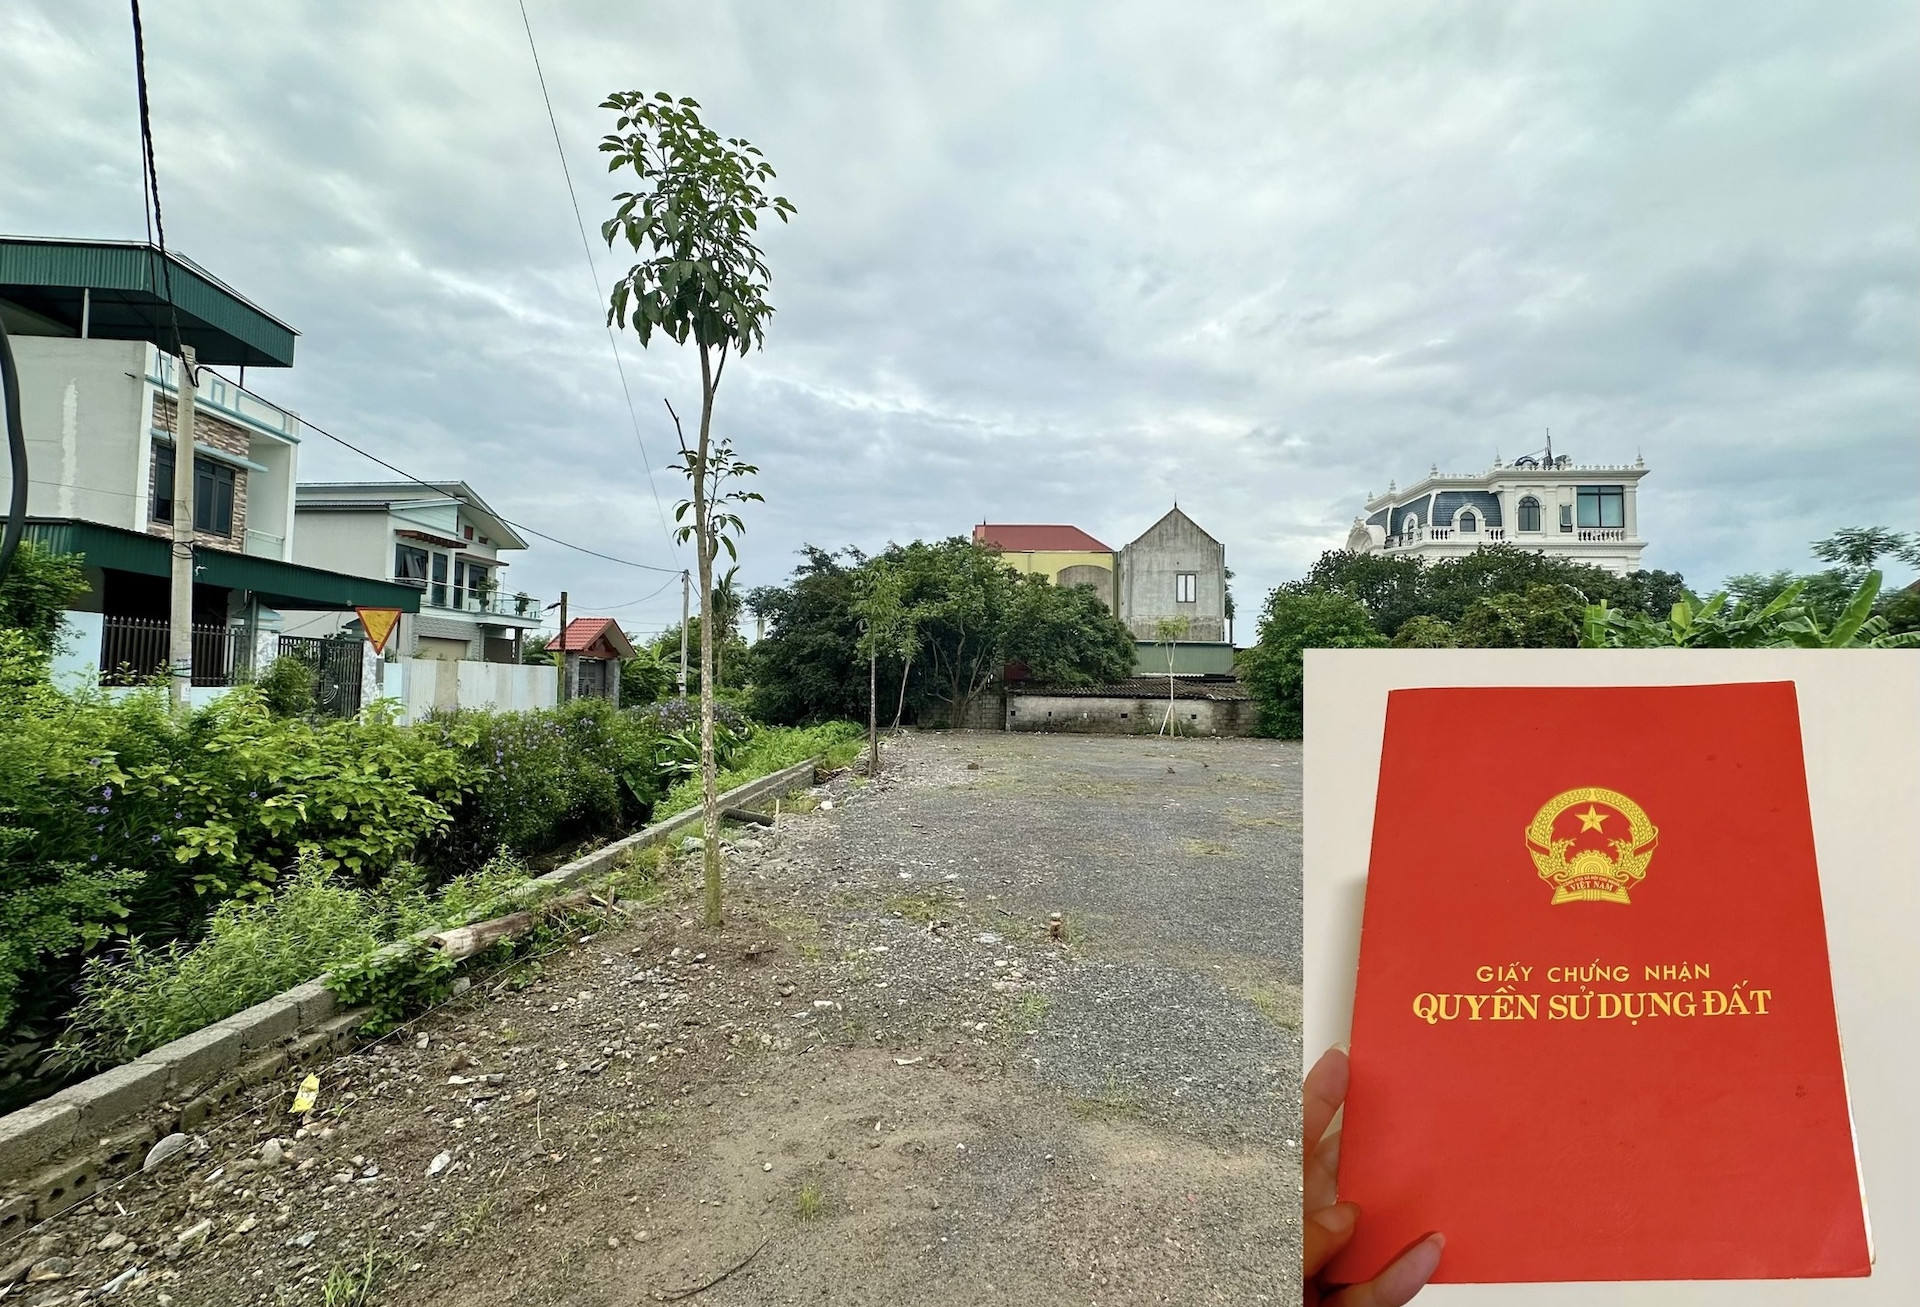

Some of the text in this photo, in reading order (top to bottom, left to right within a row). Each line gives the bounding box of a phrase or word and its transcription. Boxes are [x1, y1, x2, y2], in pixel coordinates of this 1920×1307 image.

[1570, 880, 1591, 891] VIỆT
[1593, 881, 1614, 891] NAM
[1476, 958, 1710, 983] GIẤY CHỨNG NHẬN
[1412, 980, 1772, 1026] QUYỀN SỬ DỤNG ĐẤT
